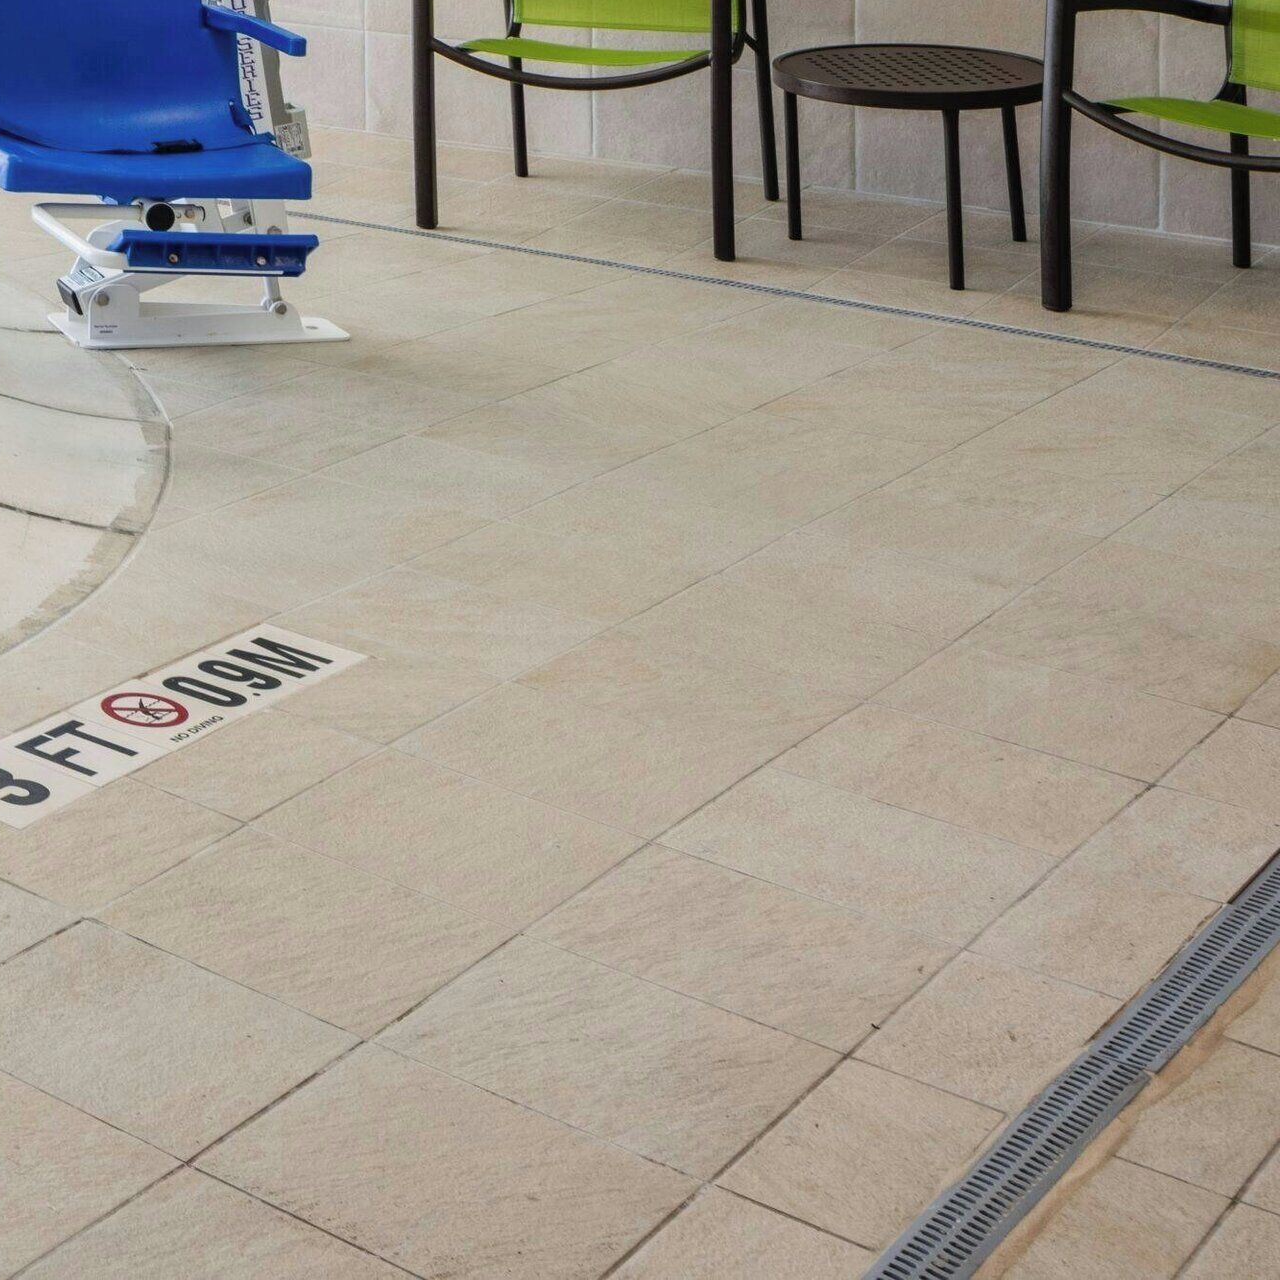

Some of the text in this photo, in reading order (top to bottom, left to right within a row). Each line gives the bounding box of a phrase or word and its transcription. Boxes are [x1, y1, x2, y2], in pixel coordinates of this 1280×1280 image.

[237, 37, 264, 121] SERIES
[15, 720, 138, 777] FT
[162, 637, 334, 708] 0.9M
[170, 715, 224, 743] NO DIVING
